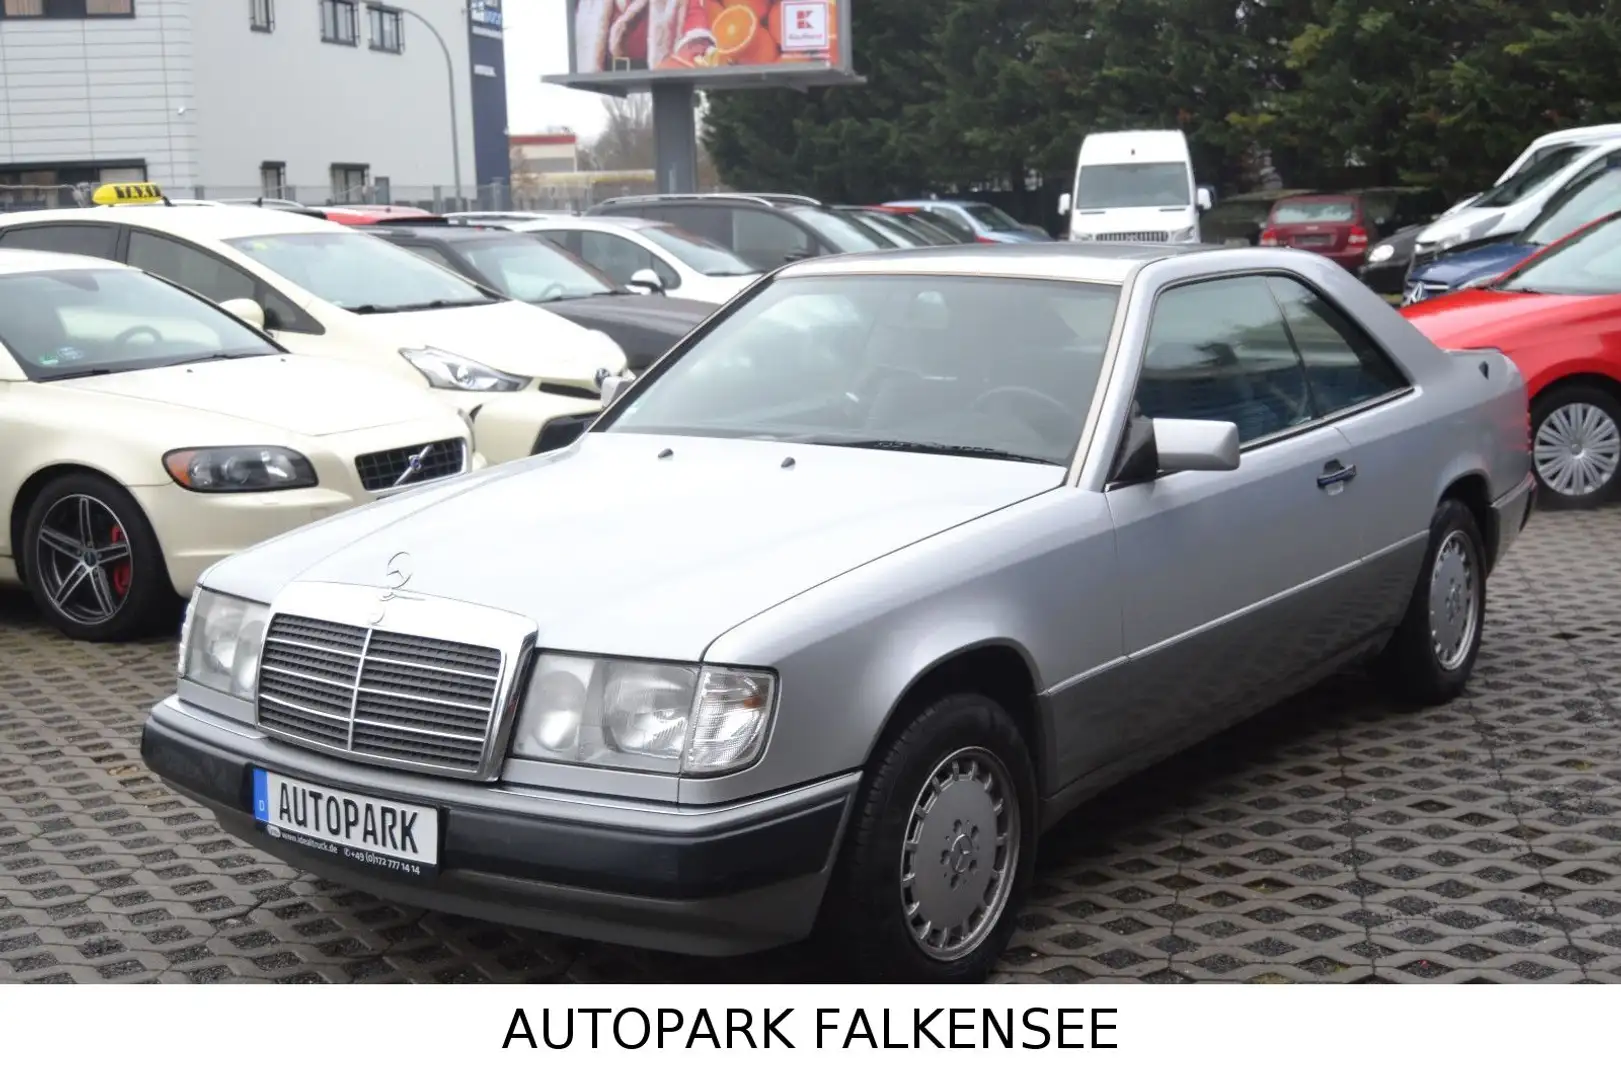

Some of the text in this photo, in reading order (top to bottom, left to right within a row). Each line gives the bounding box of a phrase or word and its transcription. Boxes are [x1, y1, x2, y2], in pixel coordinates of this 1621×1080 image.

[259, 799, 265, 812] D
[279, 783, 418, 854] AUTOPARK
[387, 859, 400, 871] 777
[401, 862, 410, 873] 14
[411, 865, 420, 876] 14
